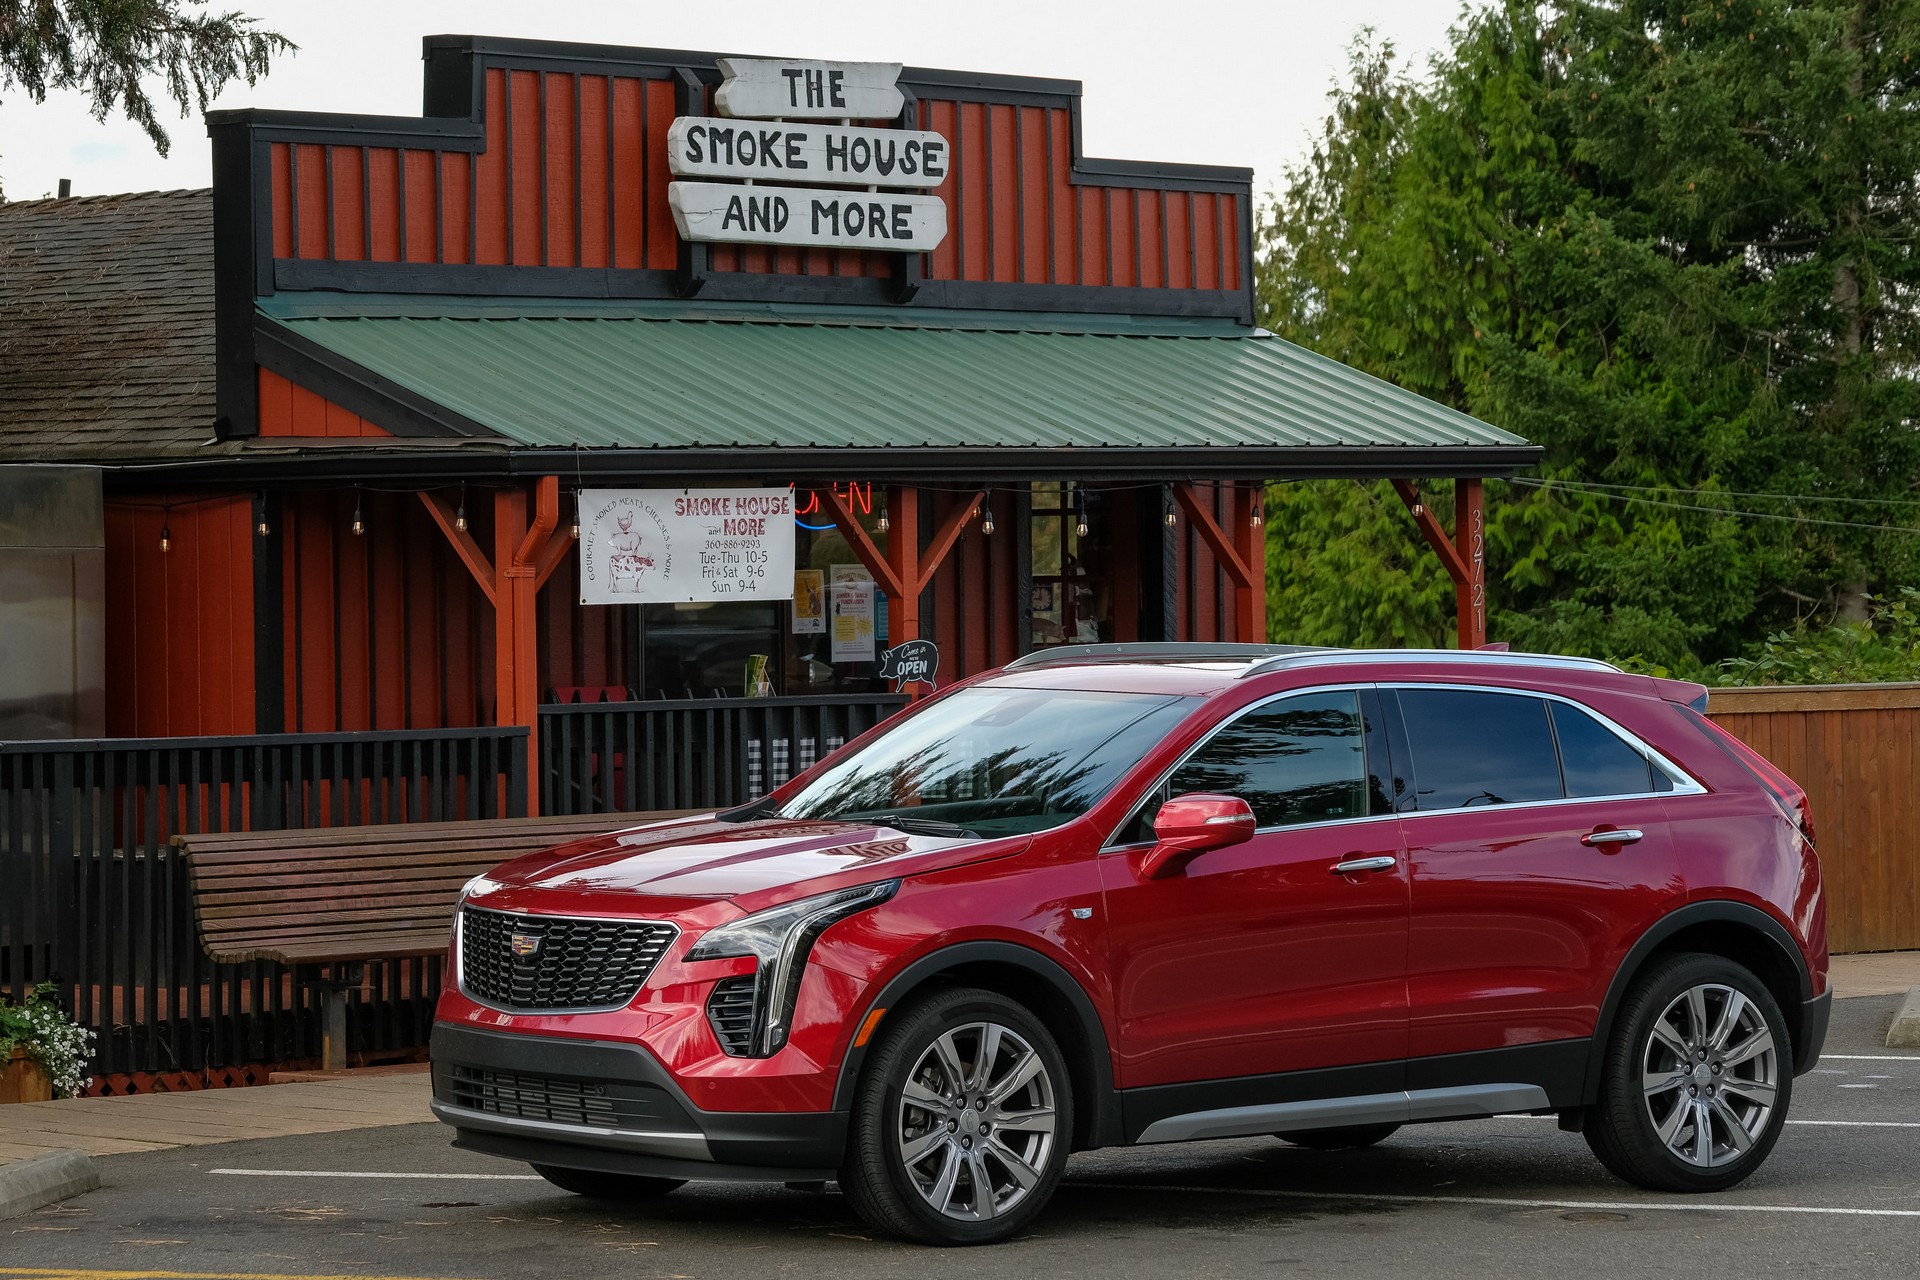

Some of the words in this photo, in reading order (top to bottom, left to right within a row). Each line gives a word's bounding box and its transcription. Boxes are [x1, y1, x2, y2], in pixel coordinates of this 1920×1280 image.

[781, 68, 846, 108] THE
[685, 125, 808, 170] SMOKE
[825, 134, 944, 177] HOUSE
[721, 195, 788, 233] AND
[811, 200, 913, 240] MORE
[674, 497, 731, 516] SMOKE
[735, 496, 790, 515] HOUSE
[706, 526, 722, 535] and
[723, 518, 766, 537] MORE
[586, 530, 596, 581] GOURMET
[619, 497, 644, 508] MEATS
[663, 552, 672, 581] MORE
[704, 539, 761, 549] 360-886-9293
[745, 550, 768, 563] 10-5
[702, 566, 715, 578] Fri
[715, 567, 721, 576] &
[723, 565, 739, 578] Sat
[746, 564, 765, 578] 9-6
[1472, 509, 1483, 632] 32721
[711, 580, 731, 593] Sun
[738, 579, 756, 593] 9-4
[901, 645, 919, 658] Come
[897, 660, 928, 675] OPEN
